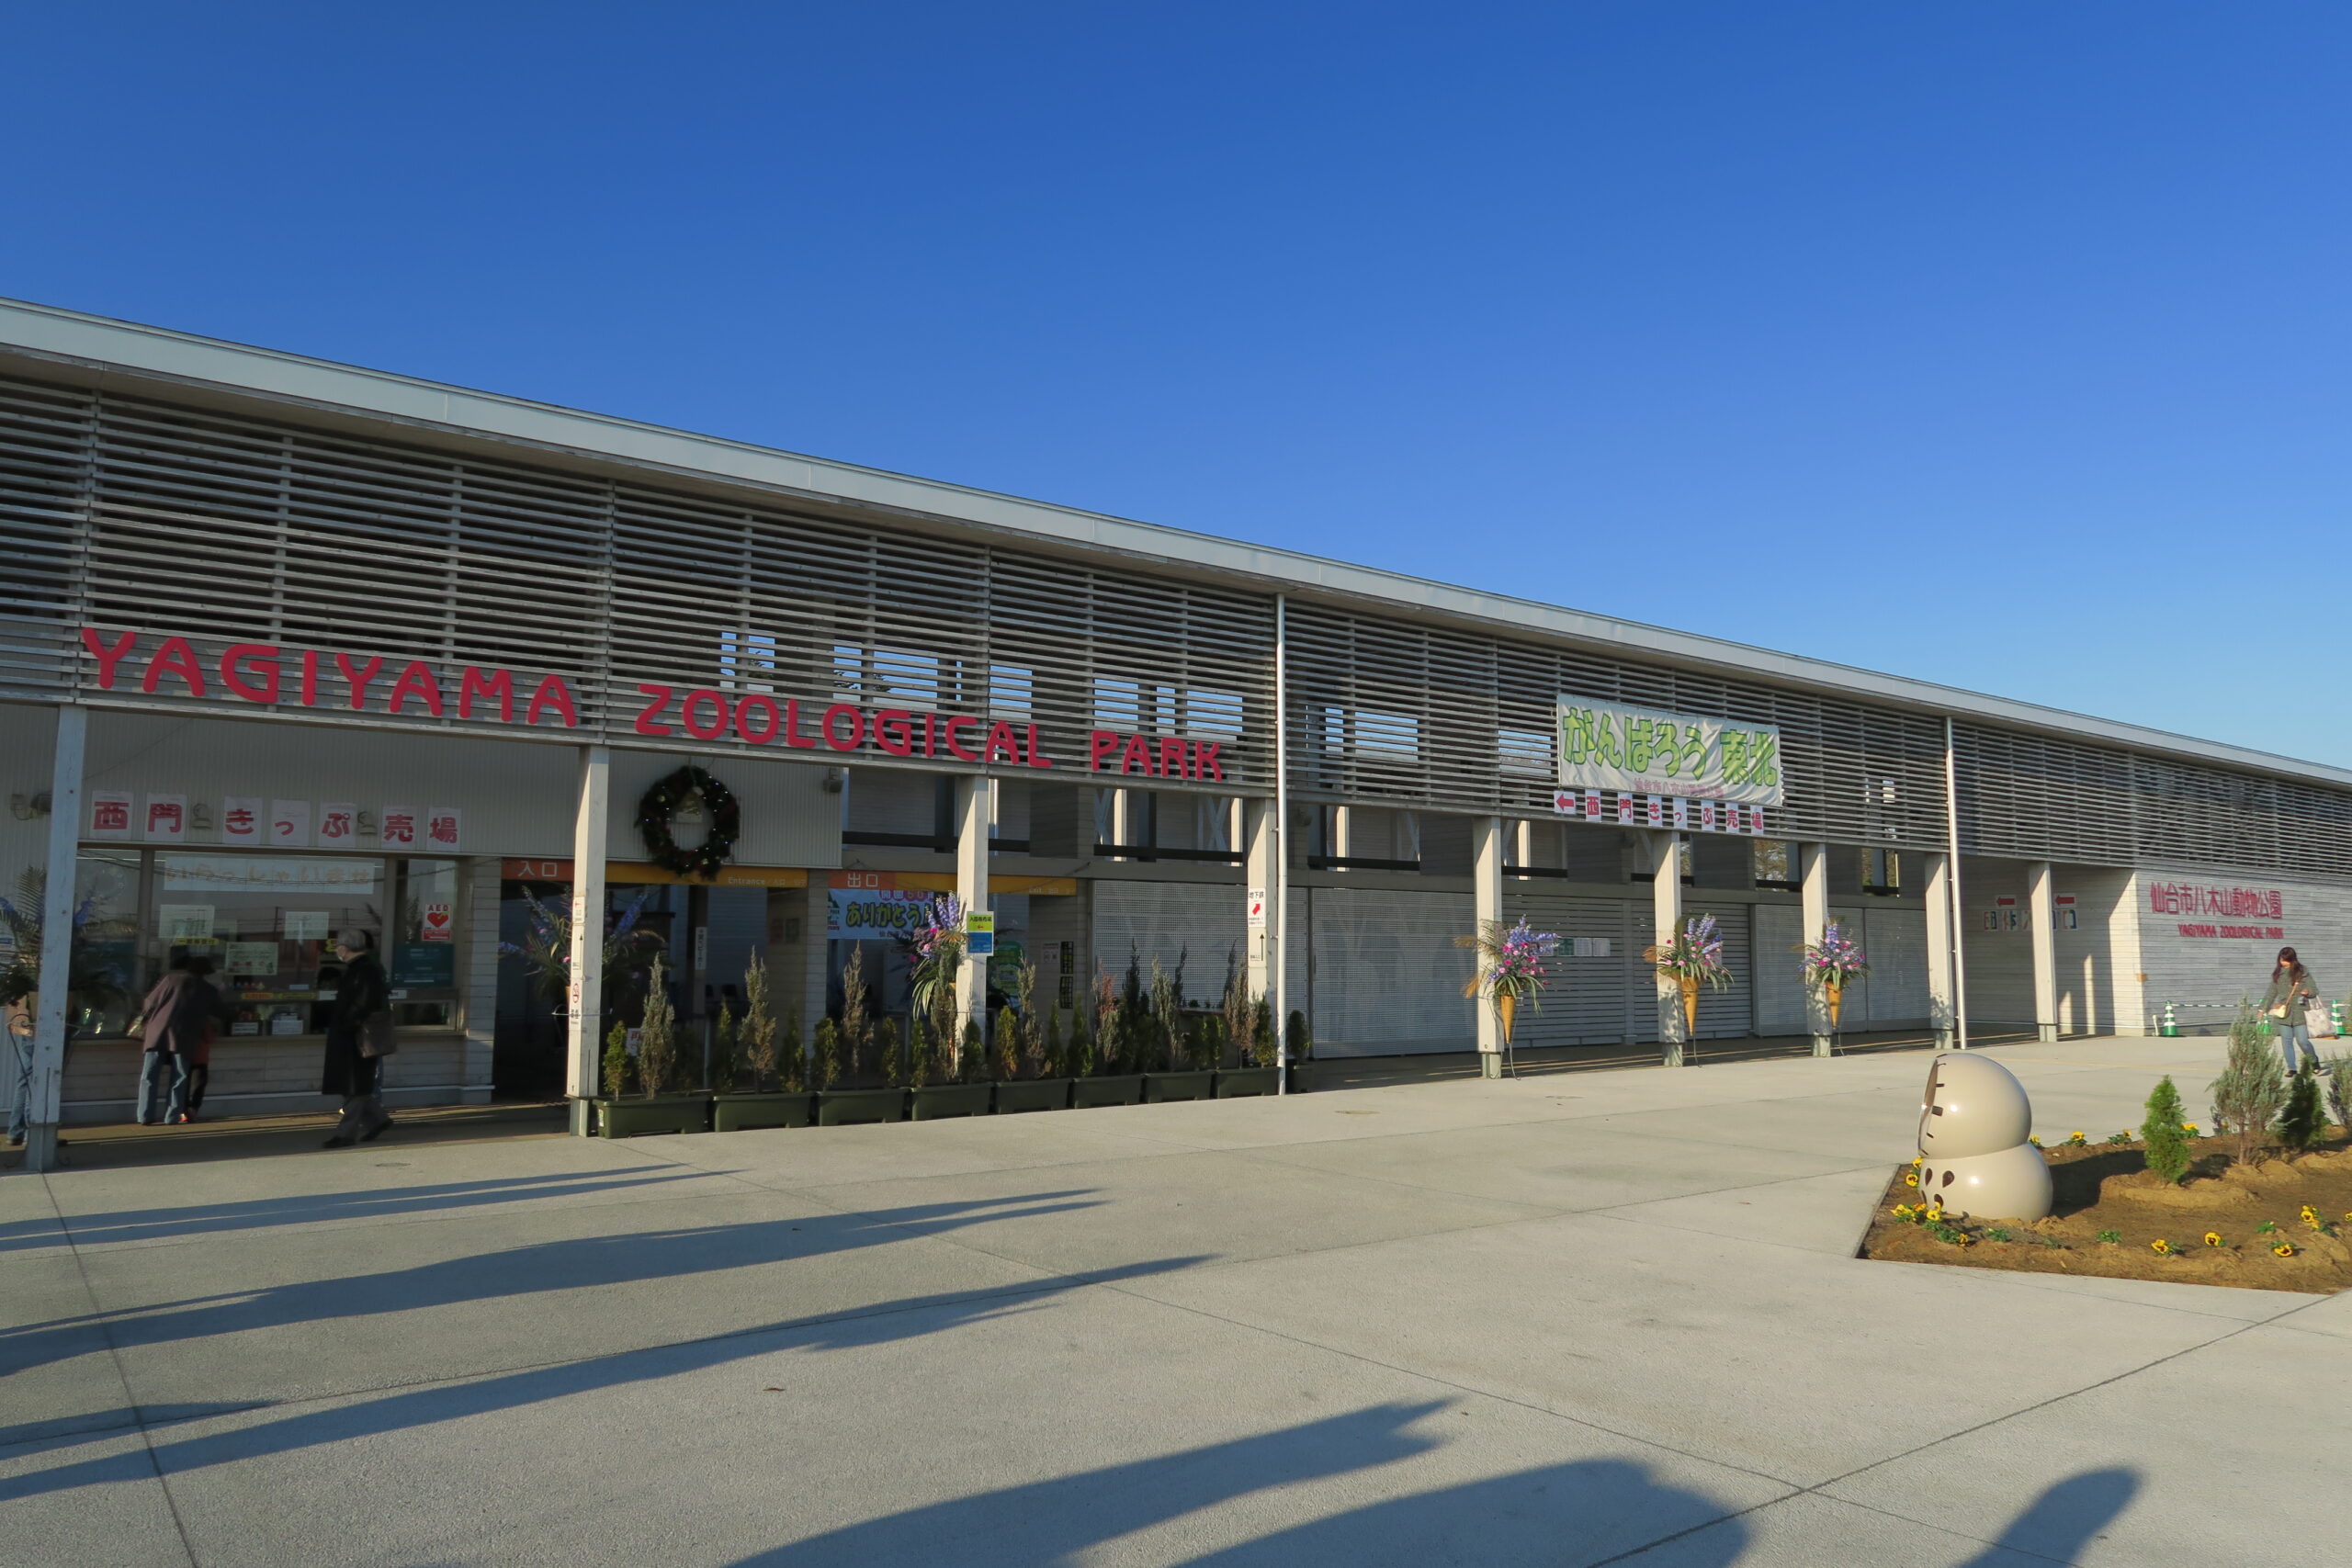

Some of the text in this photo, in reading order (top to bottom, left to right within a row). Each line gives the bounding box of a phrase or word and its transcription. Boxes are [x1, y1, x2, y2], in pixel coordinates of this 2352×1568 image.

[81, 627, 1223, 782] YAGIYAMA ZOOLOGICAL PARK
[1563, 707, 1777, 786] がんばろう 東北
[93, 801, 458, 843] 西門きっぷ売場
[1586, 795, 1763, 830] 西門きっぷ売場
[518, 861, 558, 877] 入口
[728, 876, 765, 886] Entrance
[847, 872, 878, 888] 出口
[428, 904, 449, 912] AED
[2149, 882, 2283, 919] 仙台市八木山動物公園
[2177, 923, 2284, 940] YAGIYAMA ZOOLOGICAL PARK
